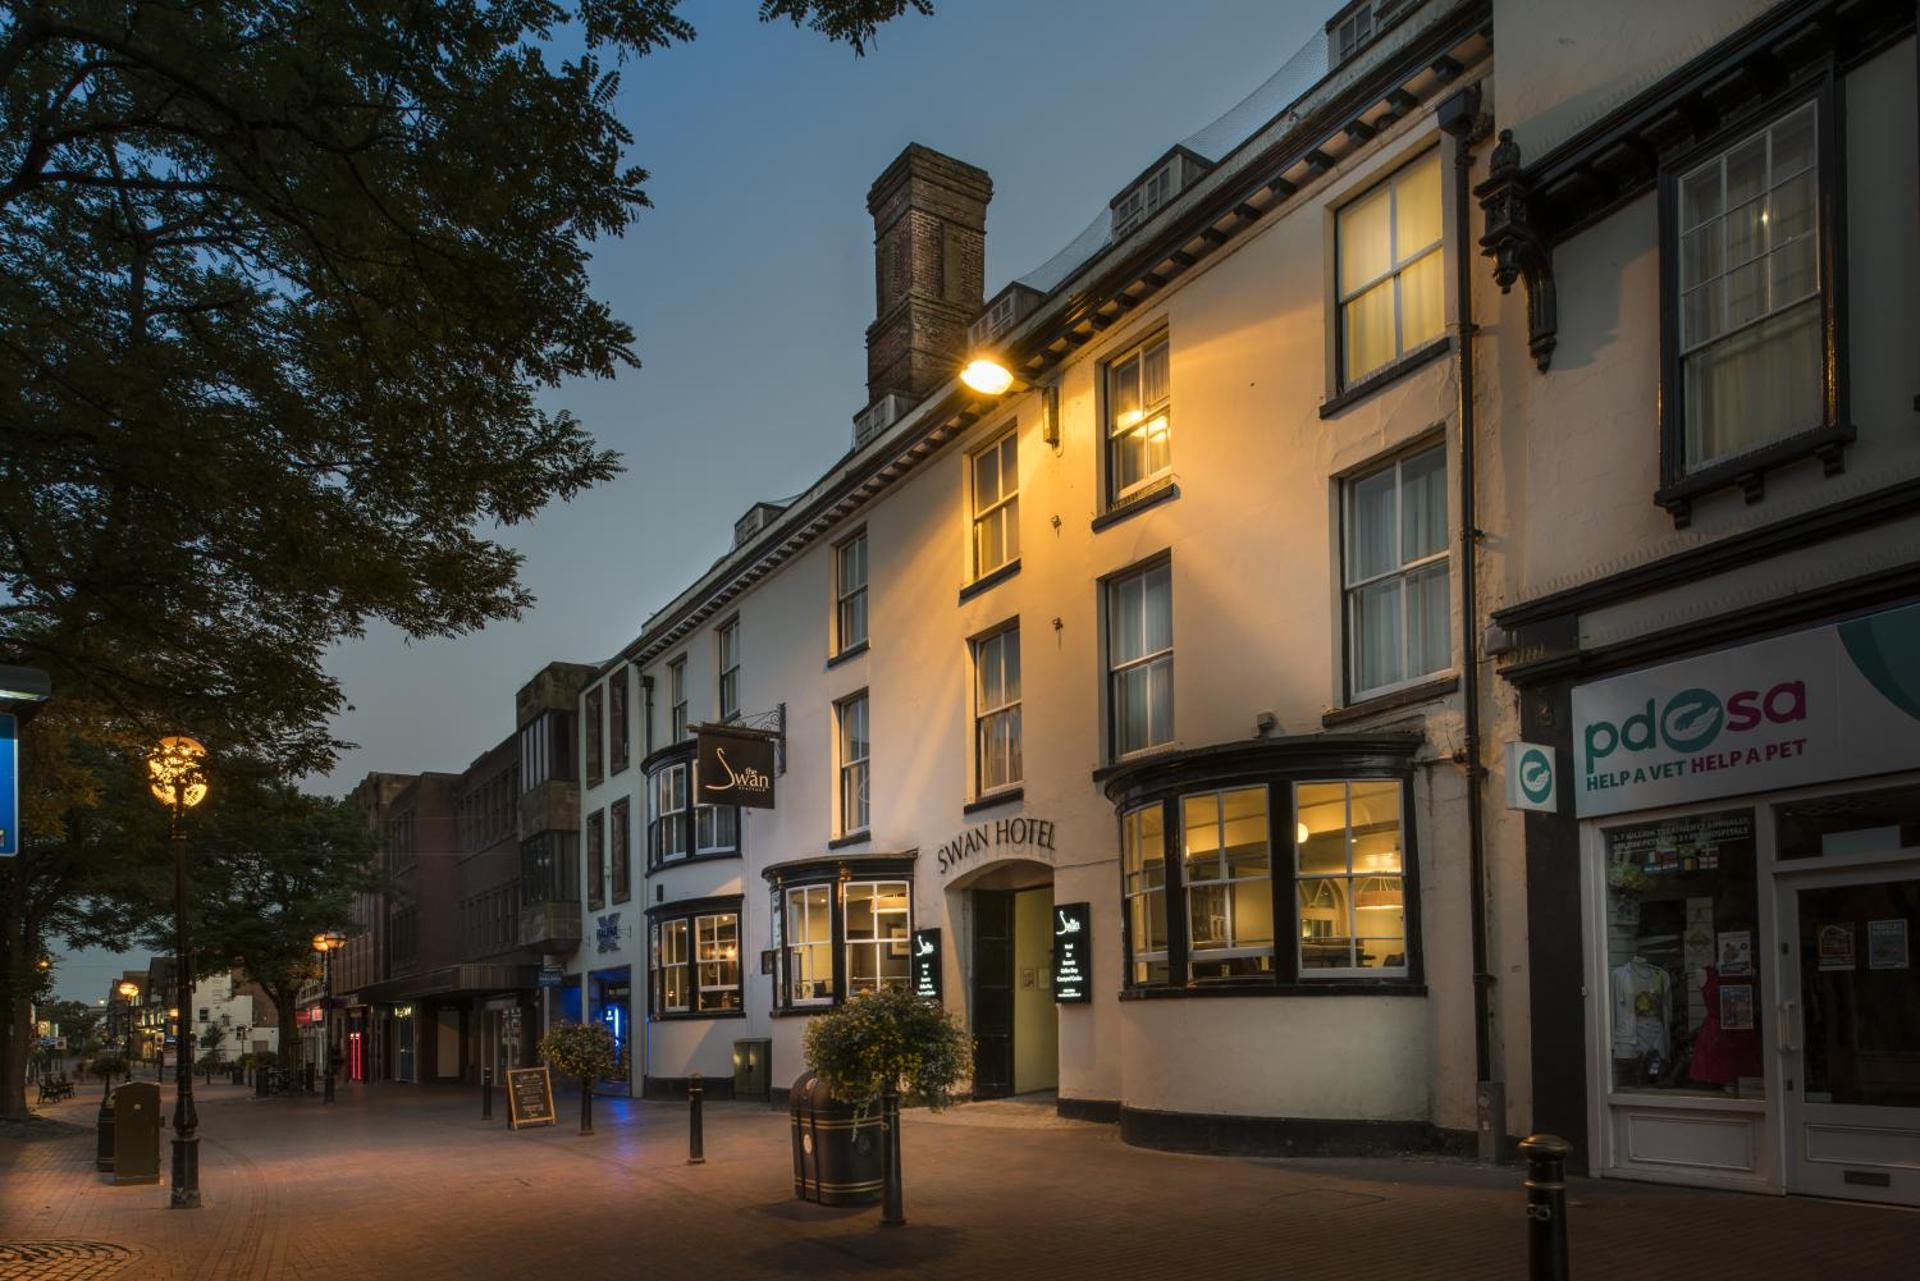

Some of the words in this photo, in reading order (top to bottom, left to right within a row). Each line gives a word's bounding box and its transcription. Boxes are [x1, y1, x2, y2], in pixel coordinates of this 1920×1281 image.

[704, 747, 770, 790] Swan
[1586, 770, 1631, 792] HELP
[1633, 769, 1646, 784] A
[1650, 759, 1687, 780] VET
[1690, 750, 1742, 774] HELP
[1745, 749, 1761, 765] A
[1766, 738, 1807, 761] PET
[937, 823, 989, 874] SWAN
[996, 817, 1056, 850] HOTEL
